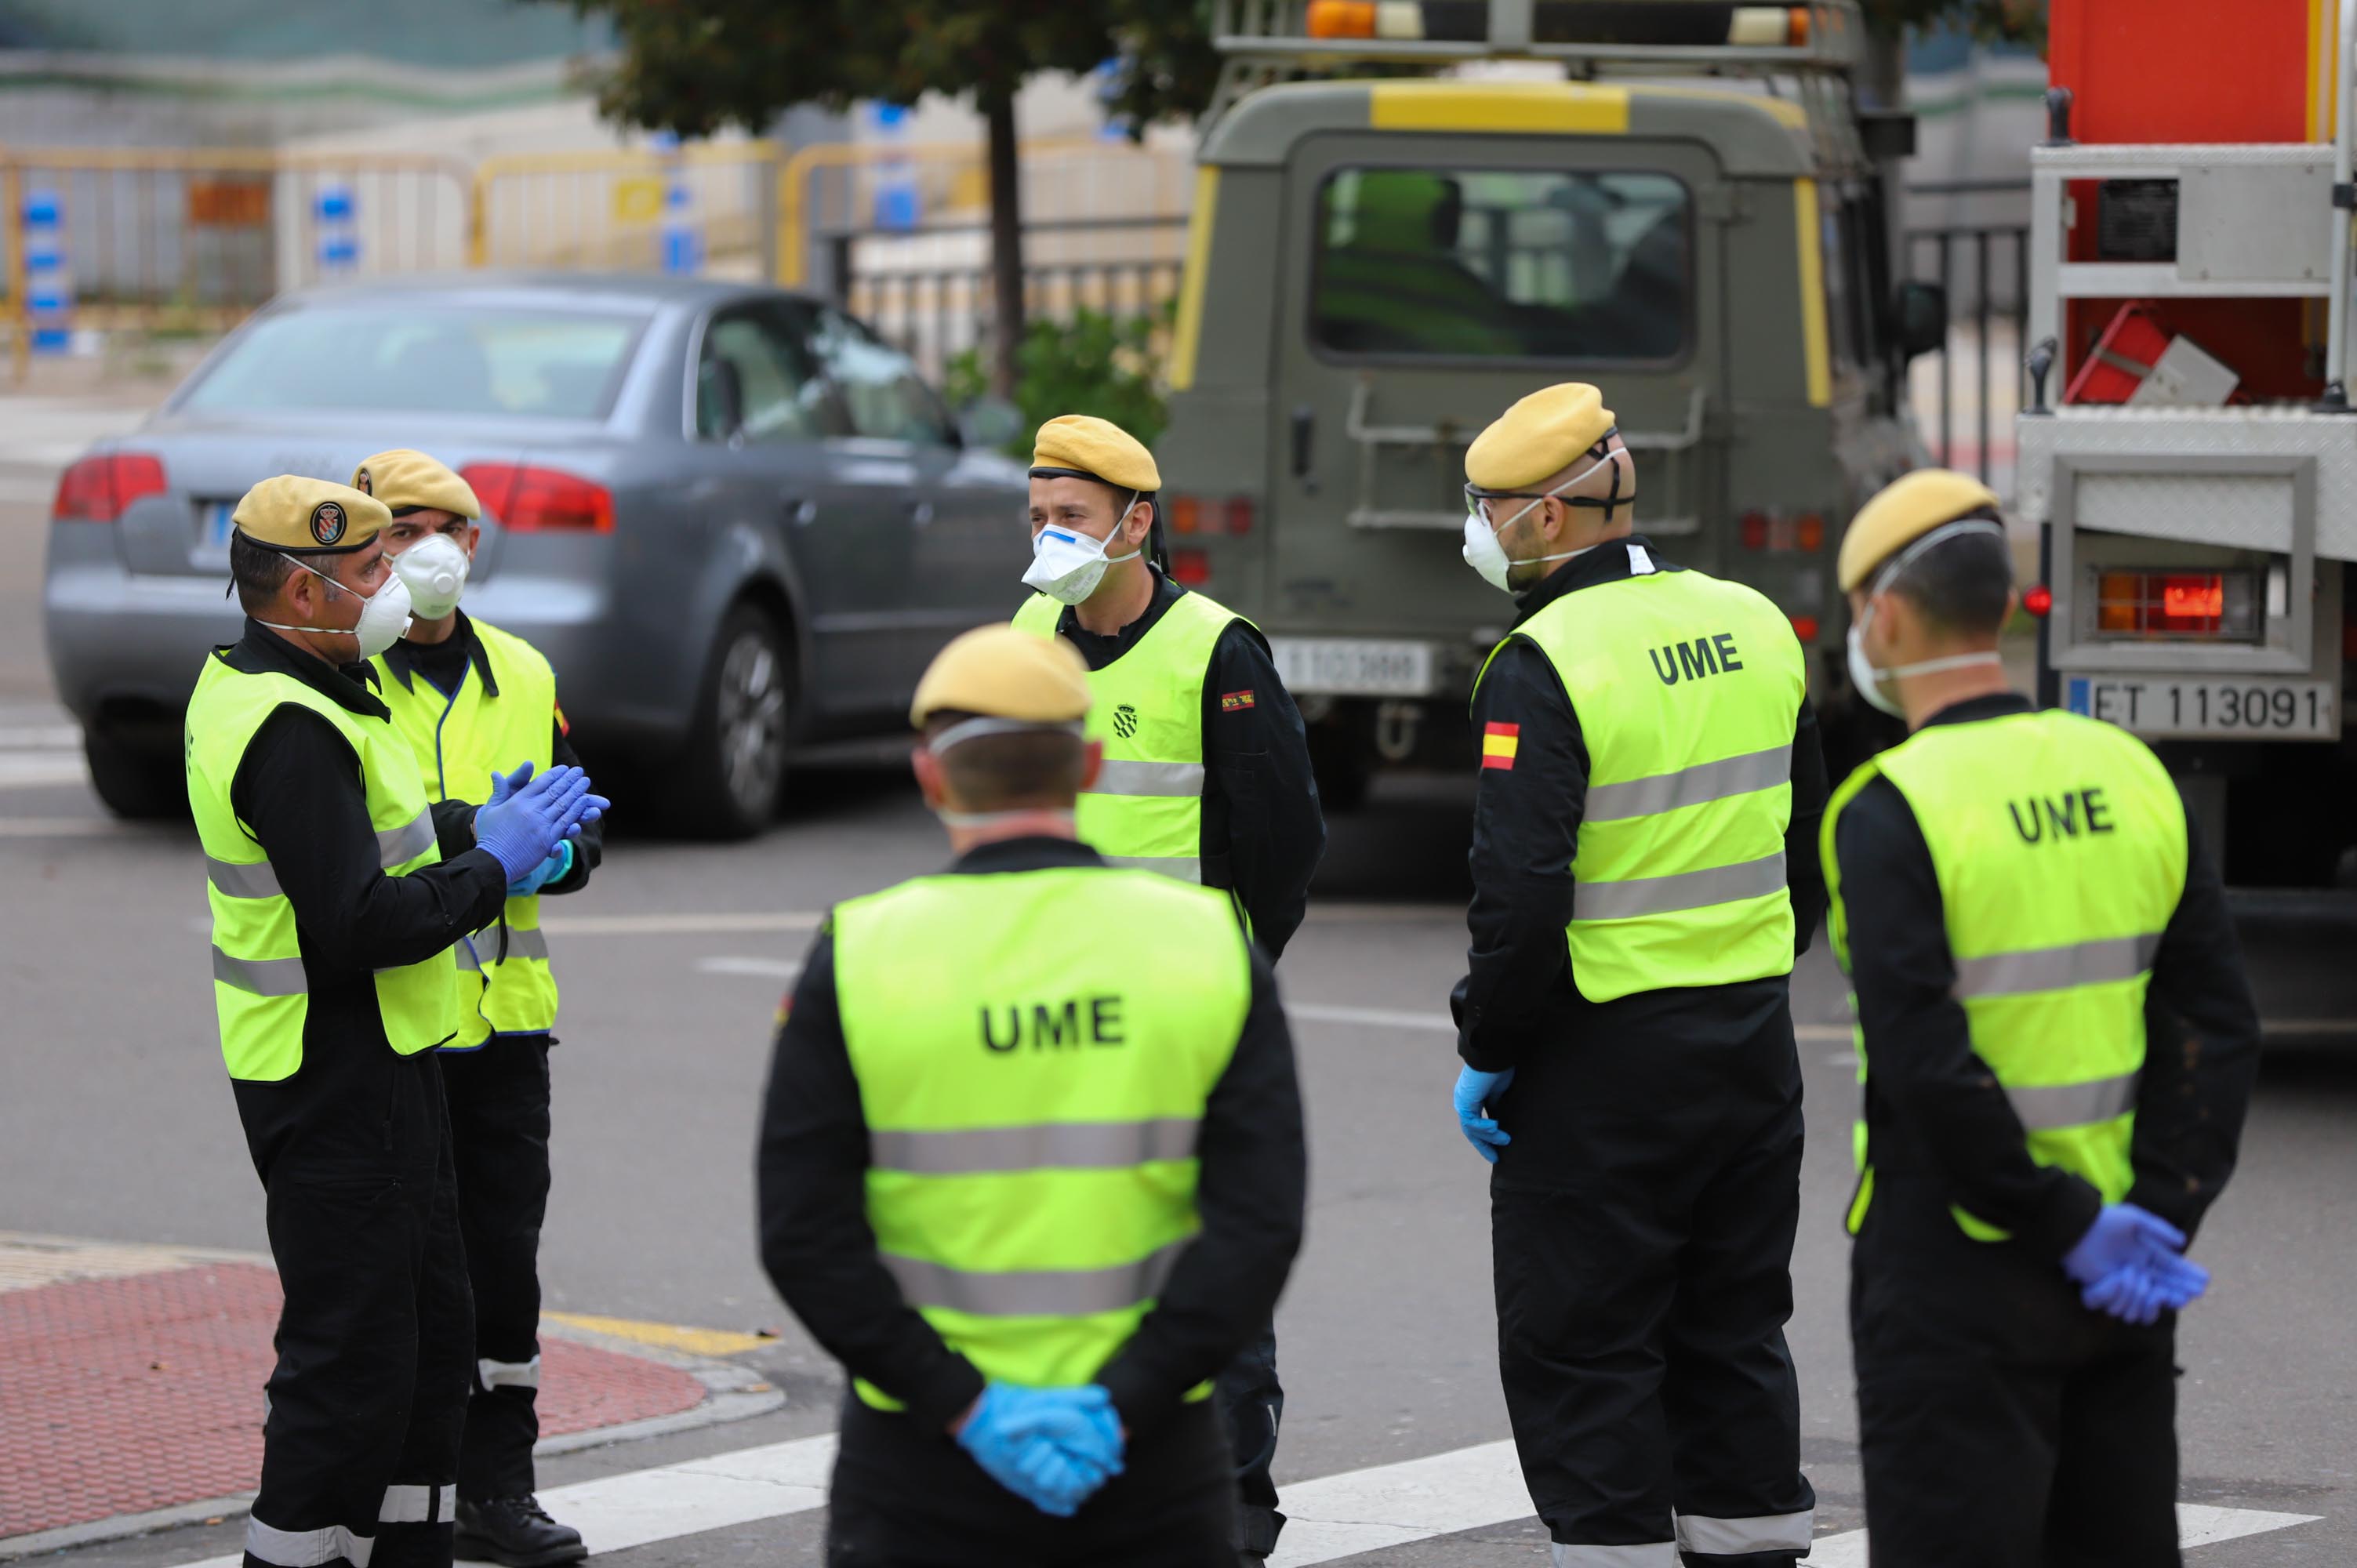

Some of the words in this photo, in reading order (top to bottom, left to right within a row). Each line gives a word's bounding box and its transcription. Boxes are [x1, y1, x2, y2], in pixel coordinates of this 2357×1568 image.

[1647, 633, 1744, 686] UME
[2094, 684, 2145, 726] ET
[2168, 685, 2319, 729] 113091
[981, 995, 1126, 1054] UME
